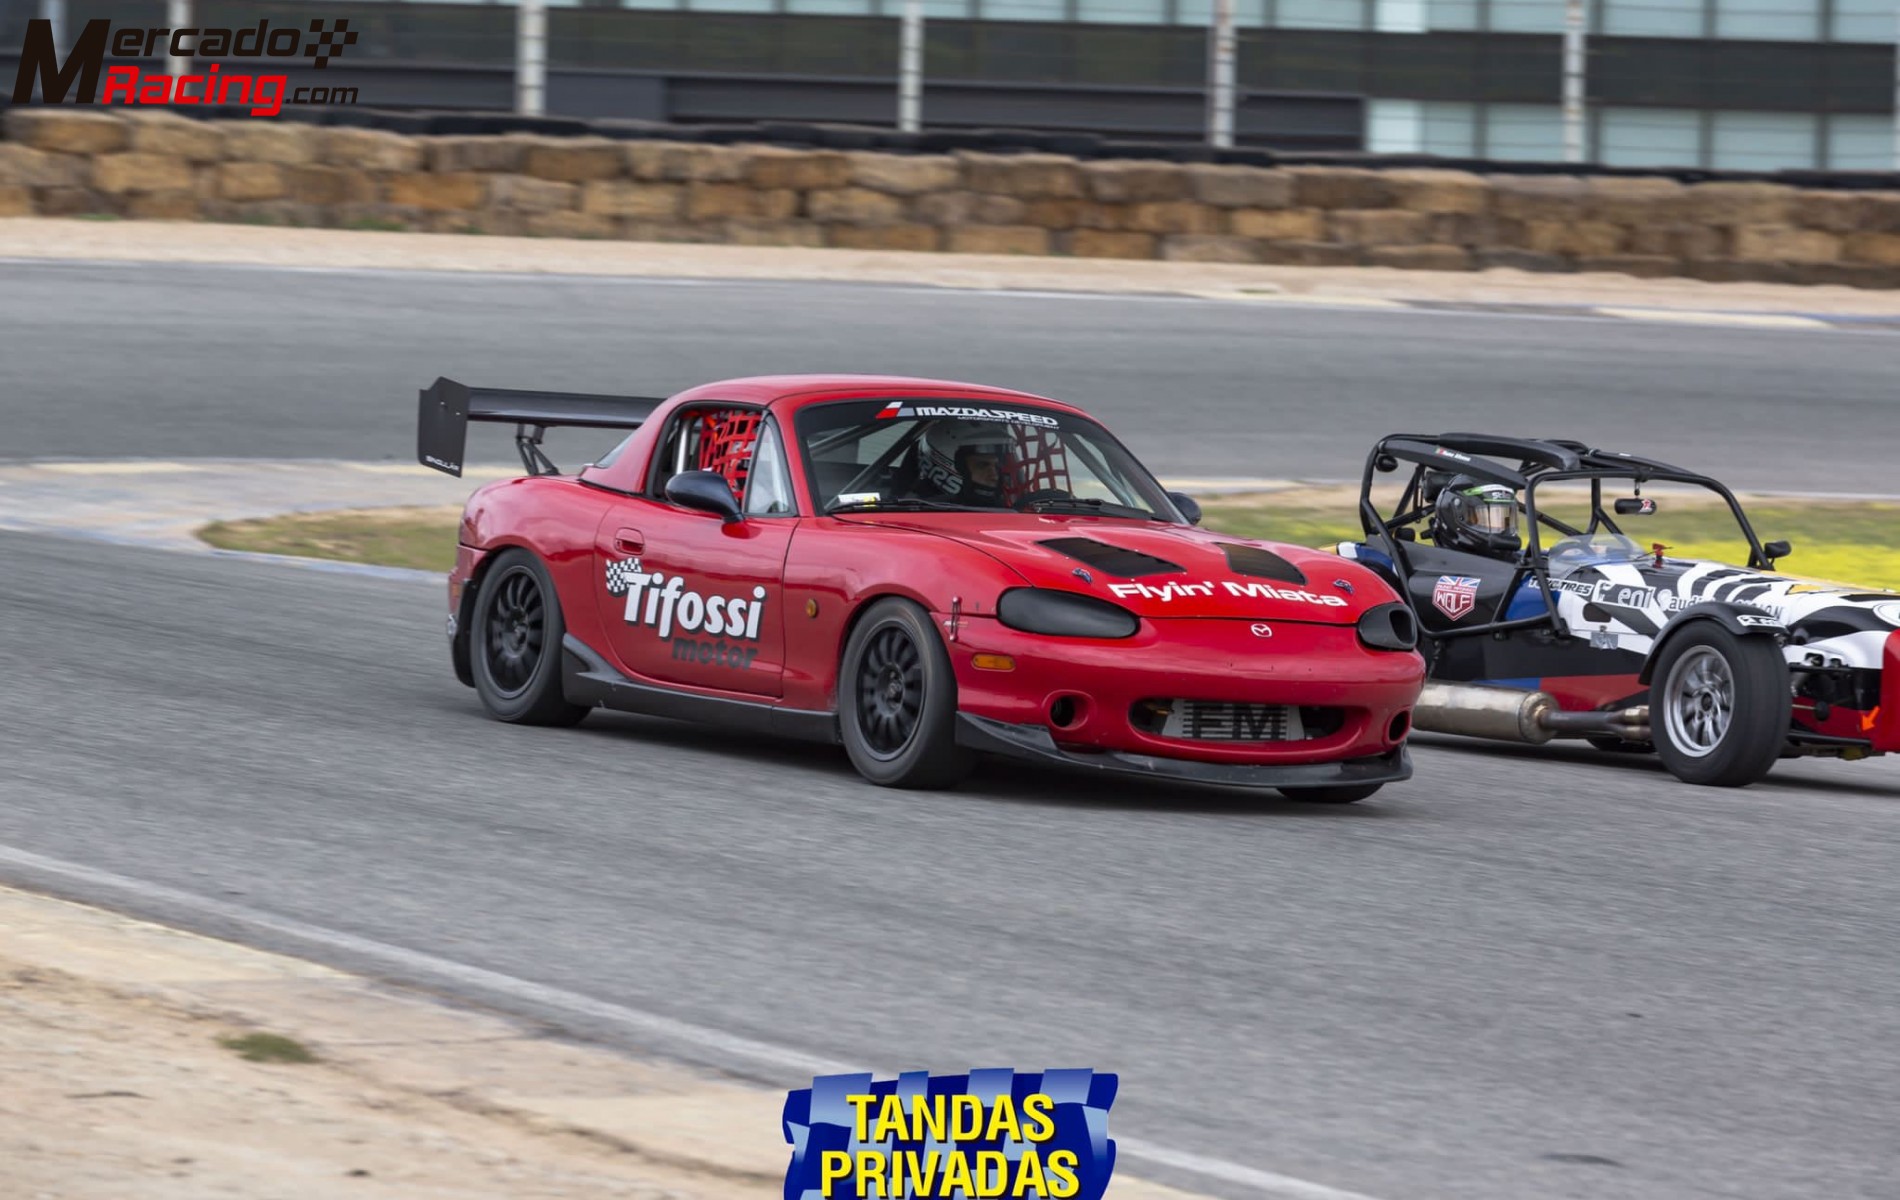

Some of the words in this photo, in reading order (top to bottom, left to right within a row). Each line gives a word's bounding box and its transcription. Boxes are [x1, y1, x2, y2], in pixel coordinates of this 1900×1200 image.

[916, 407, 1058, 426] MAZDASPEED
[1106, 580, 1216, 602] Flyin'
[1221, 581, 1349, 606] Miata
[1559, 581, 1592, 595] TIRES
[1617, 587, 1653, 609] eni
[623, 572, 767, 640] Tifossi
[672, 637, 759, 670] motor
